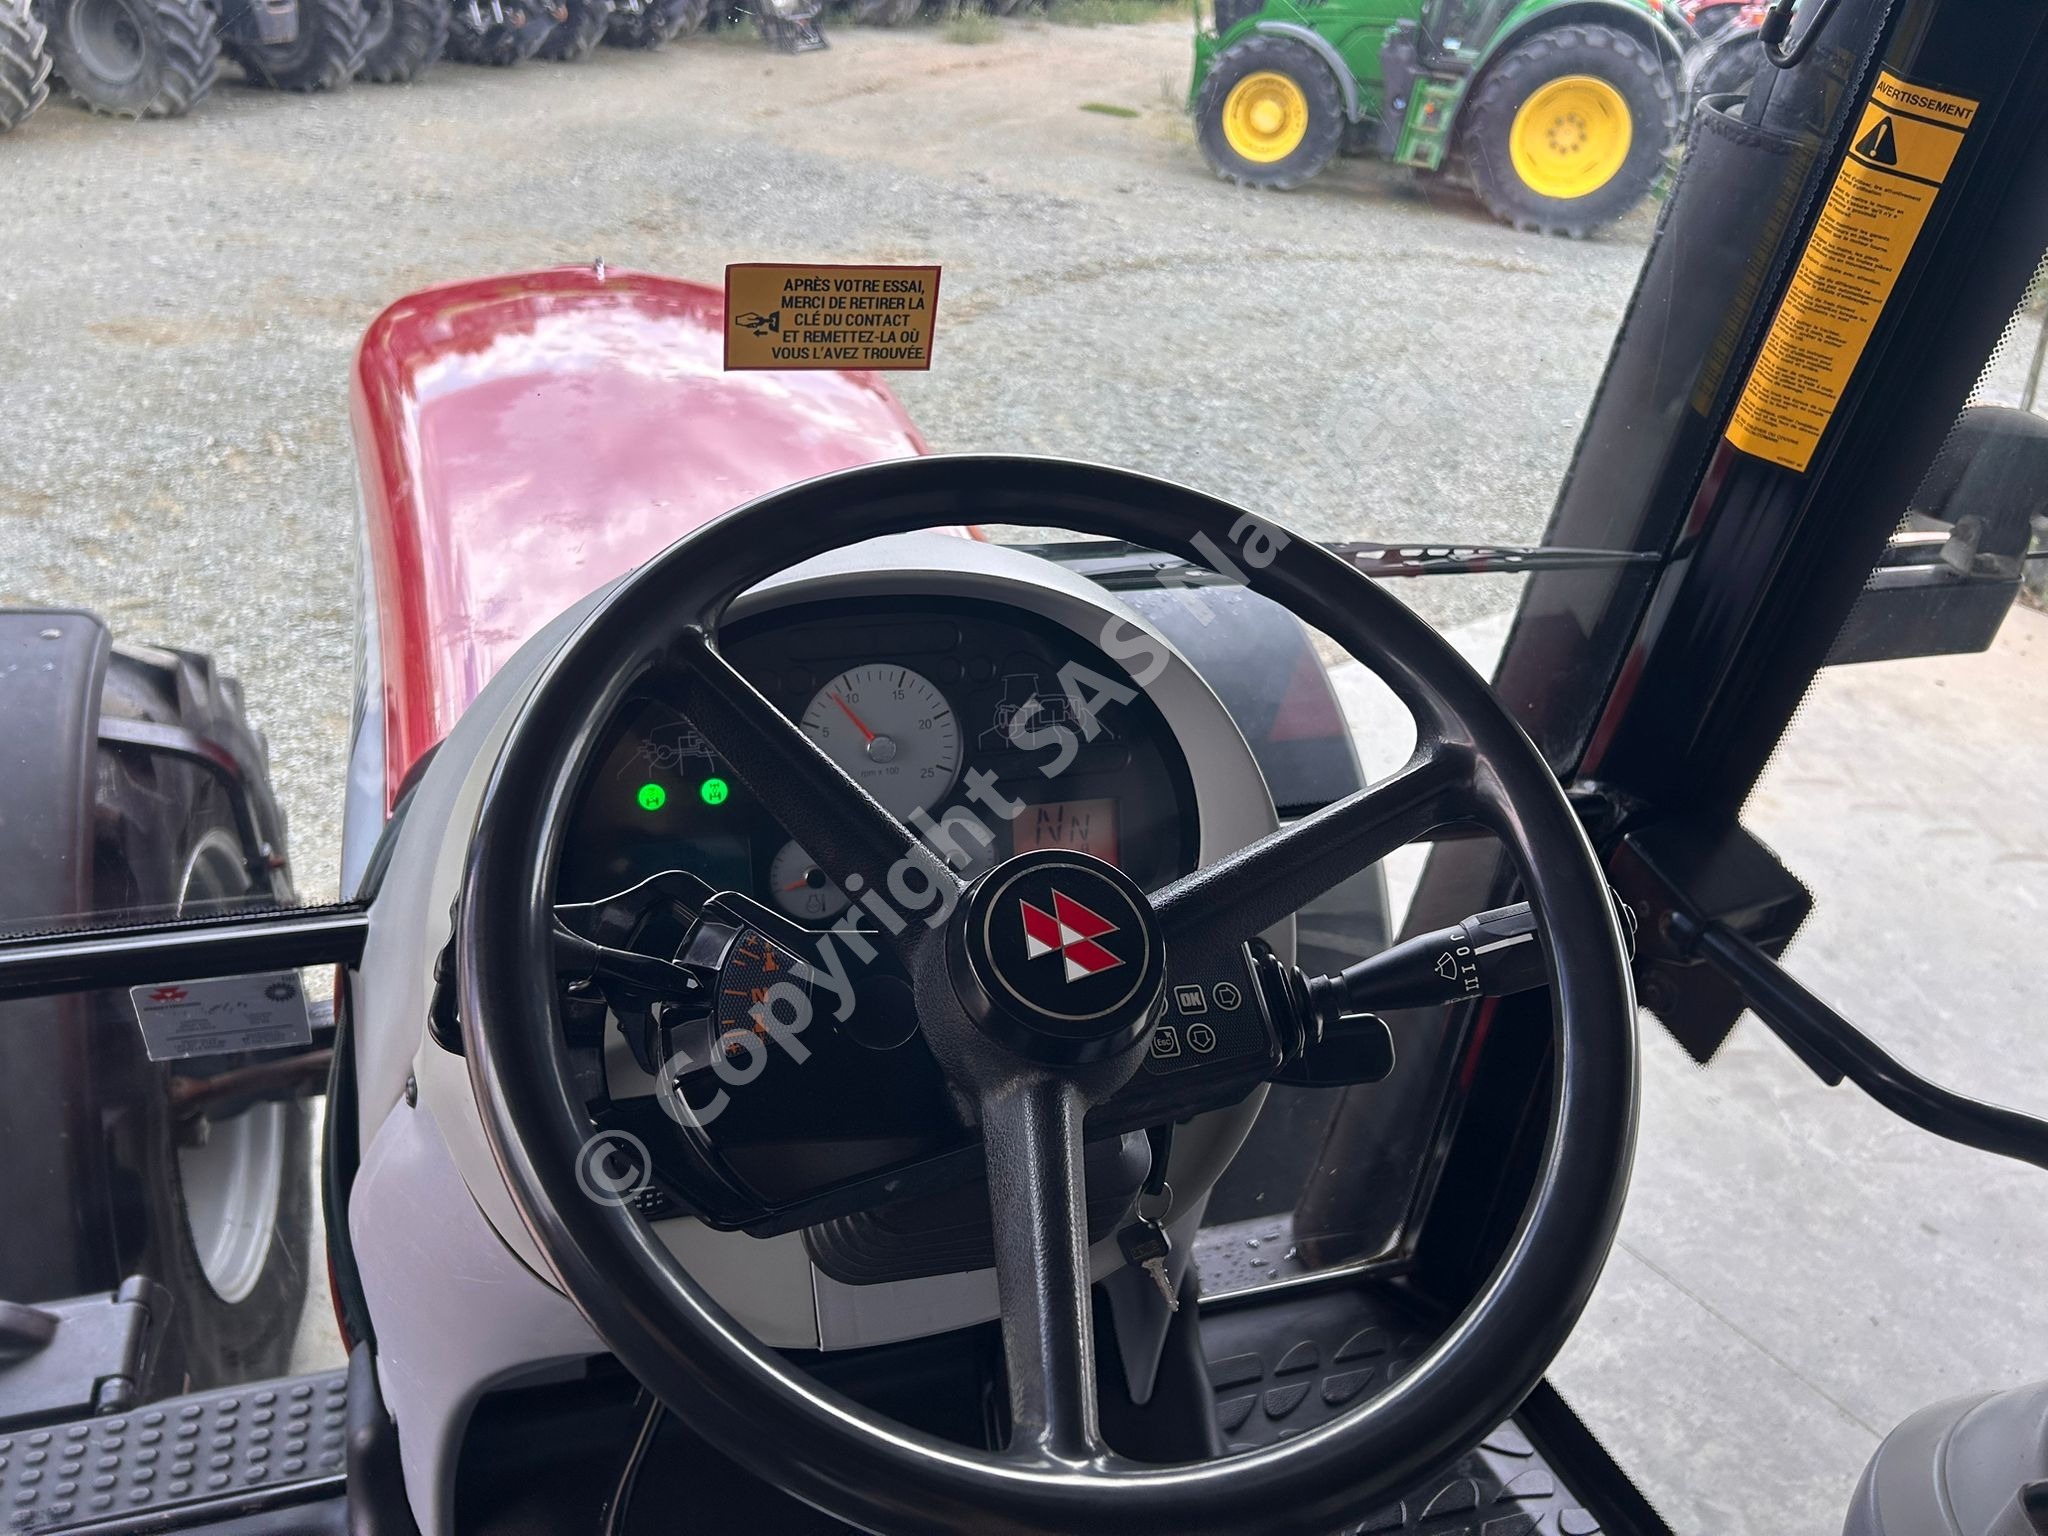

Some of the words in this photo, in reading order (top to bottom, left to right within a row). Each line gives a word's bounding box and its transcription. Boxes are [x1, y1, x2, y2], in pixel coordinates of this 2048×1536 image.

[1877, 81, 1973, 119] AVERTISSEMENT
[784, 276, 830, 292] APRÈS
[834, 279, 880, 292] VOTRE
[883, 280, 925, 294] ESSAI,
[781, 296, 825, 309] MERCI
[829, 296, 846, 309] DE
[850, 297, 904, 309] RETIRER
[908, 297, 925, 310] LA
[794, 311, 820, 326] CLÉ
[823, 314, 842, 327] DU
[845, 314, 910, 327] CONTACT
[783, 330, 798, 343] ET
[803, 330, 896, 343] REMETTEZ-LA
[900, 328, 919, 343] OÙ
[771, 347, 809, 359] VOUS
[813, 347, 859, 360] L'AVEZ
[863, 345, 925, 360] TROUVÉE.
[846, 693, 859, 704] 10
[893, 689, 905, 700] 15
[918, 719, 932, 730] 20
[822, 727, 830, 738] 5
[861, 769, 876, 777] rpm
[885, 767, 899, 775] 100
[921, 768, 935, 778] 25
[1180, 991, 1202, 1007] OK
